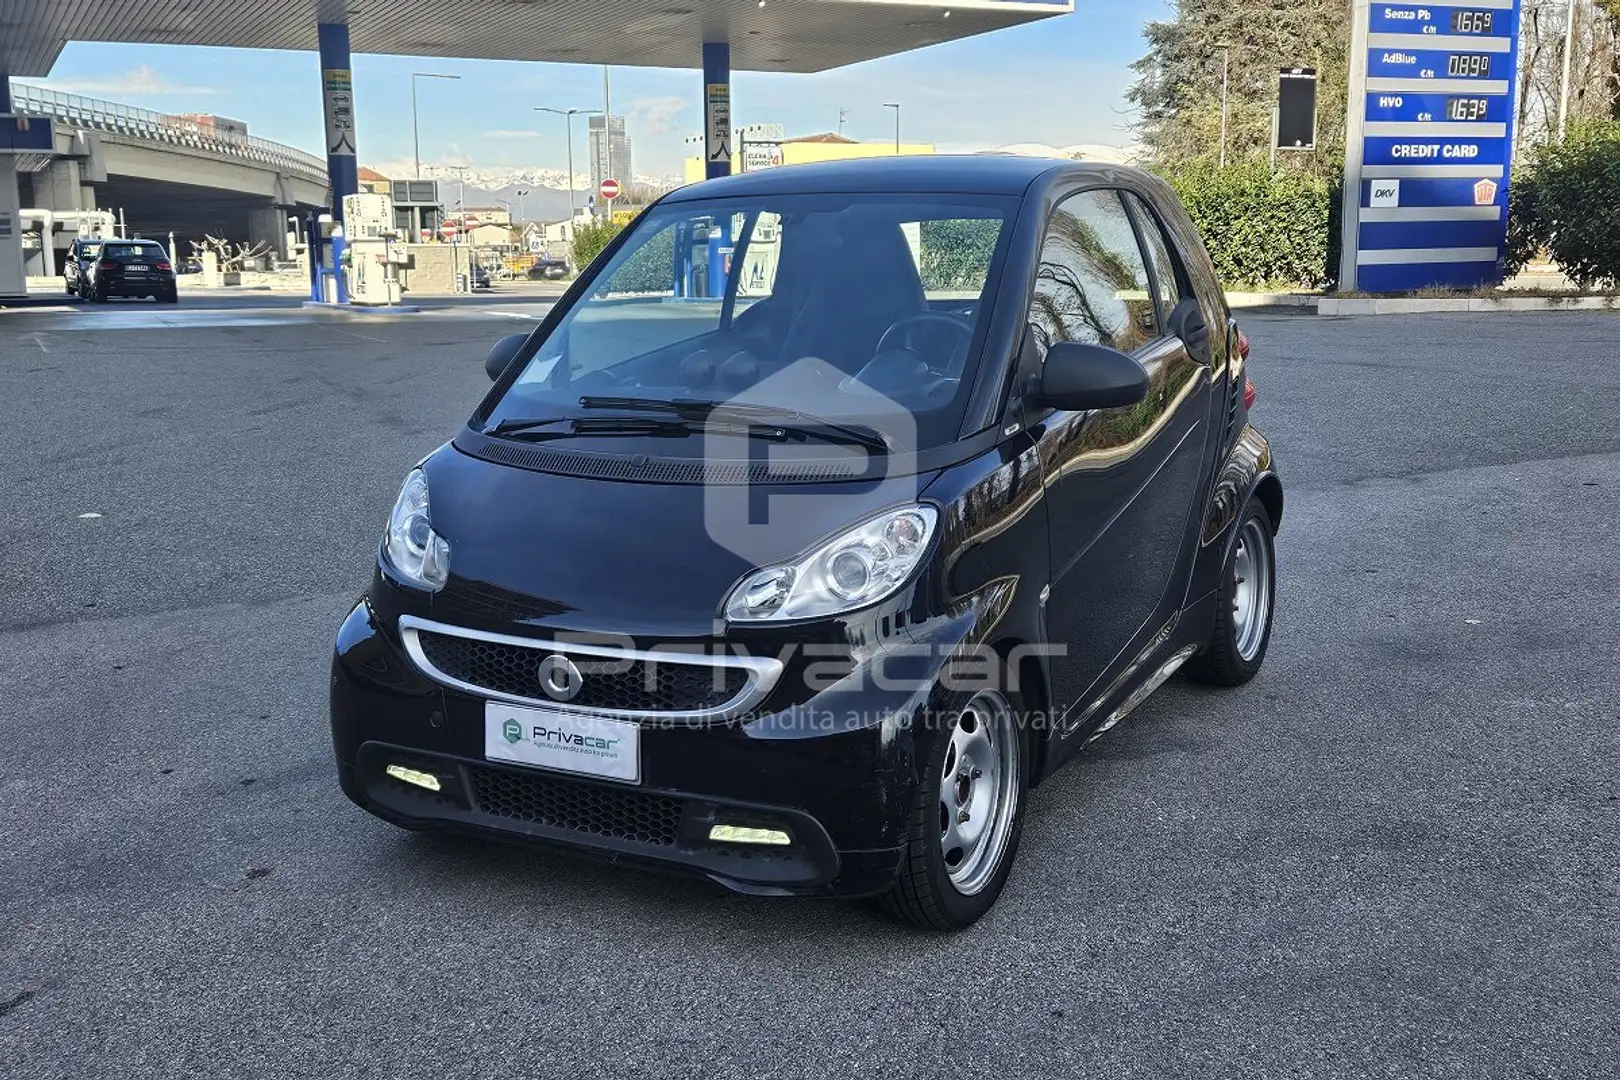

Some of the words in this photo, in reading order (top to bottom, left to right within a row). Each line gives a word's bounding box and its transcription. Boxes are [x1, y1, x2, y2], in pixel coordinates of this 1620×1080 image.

[1384, 8, 1415, 20] Senza
[1417, 9, 1431, 20] Pb
[1382, 53, 1417, 65] AdBlue
[1379, 96, 1403, 108] HVO
[1391, 144, 1441, 158] CREDIT
[1442, 144, 1479, 158] CARD
[1374, 188, 1396, 199] DKV
[533, 726, 618, 750] Privacar
